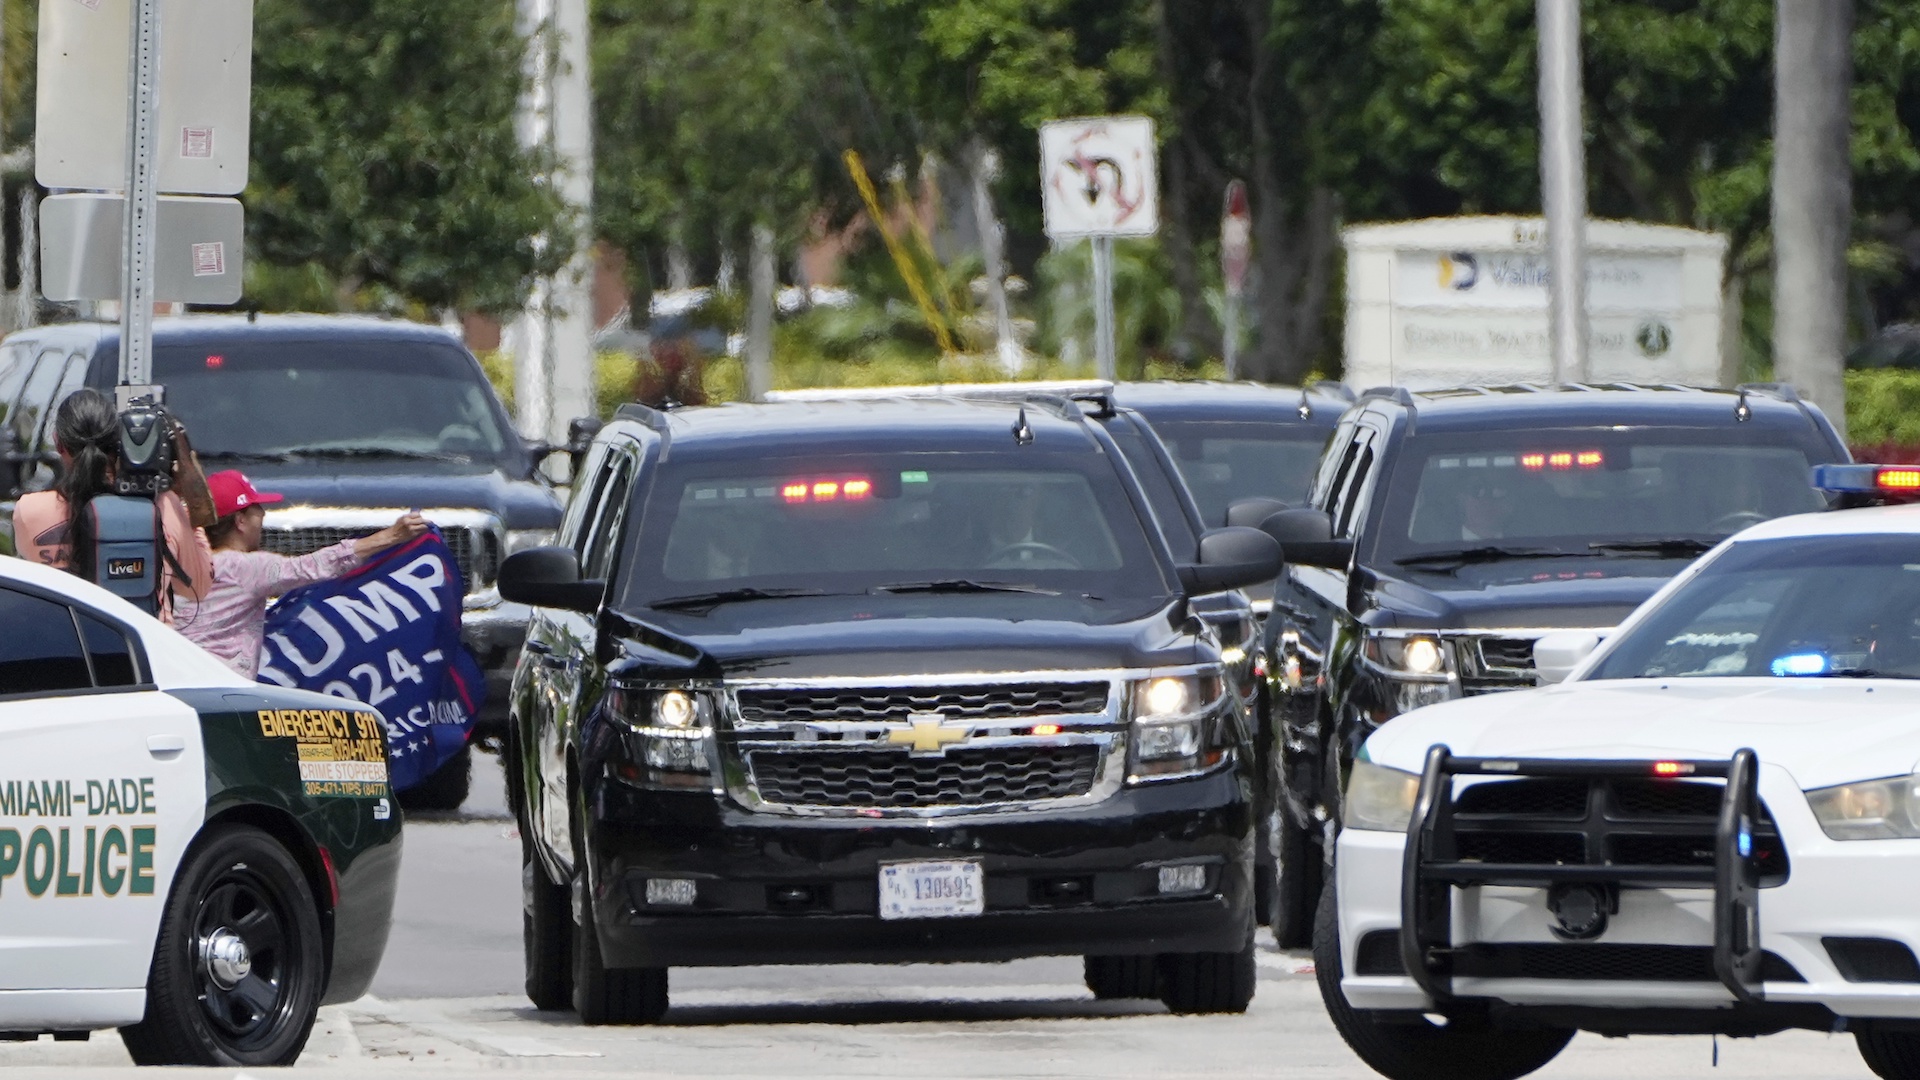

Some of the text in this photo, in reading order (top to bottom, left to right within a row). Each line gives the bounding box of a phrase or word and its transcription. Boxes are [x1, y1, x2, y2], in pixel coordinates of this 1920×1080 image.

[108, 560, 142, 575] LiveU
[257, 709, 380, 738] EMERGENCY 911
[300, 763, 387, 780] CRIME STOPPERS
[0, 777, 157, 817] MIAMI-DADE
[305, 782, 387, 796] 305-471-TIPS (8477)
[0, 824, 157, 900] POLICE
